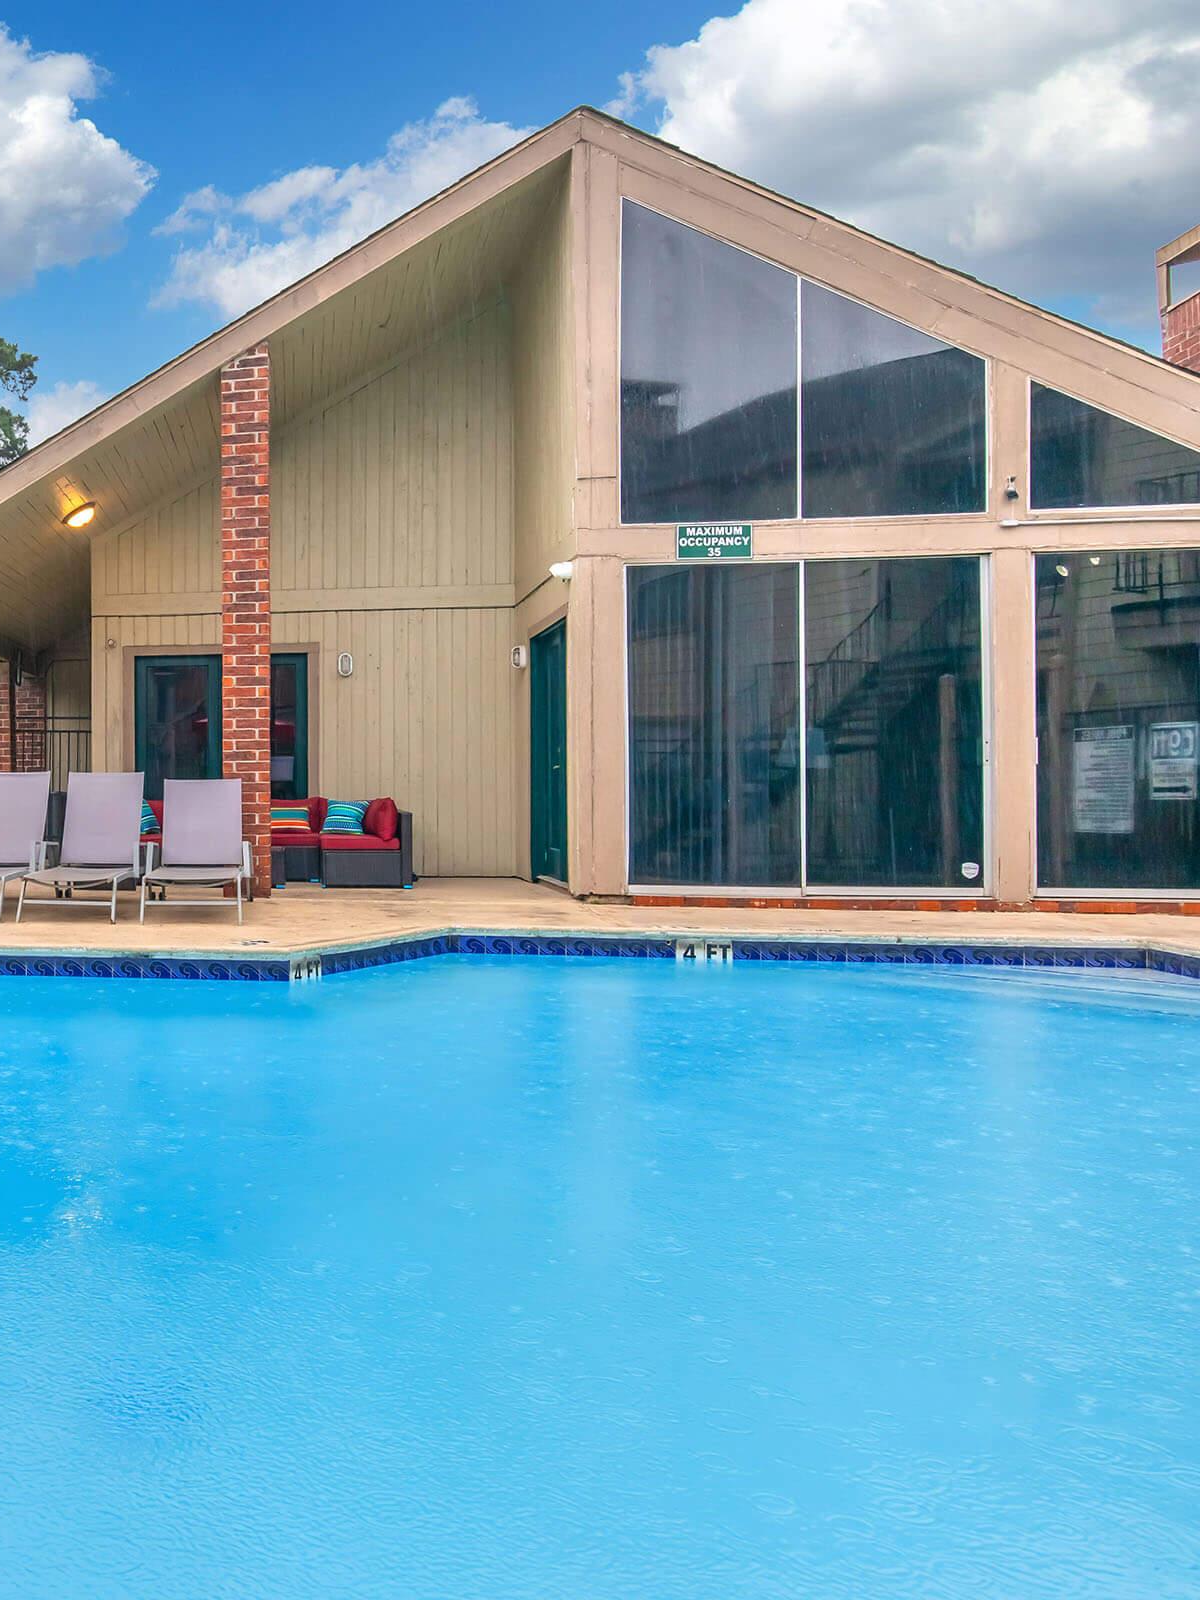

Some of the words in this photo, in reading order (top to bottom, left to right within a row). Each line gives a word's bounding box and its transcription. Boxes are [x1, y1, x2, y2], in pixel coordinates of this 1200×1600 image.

[686, 526, 743, 536] MAXIMUM
[679, 536, 750, 546] OCCUPANCY
[707, 547, 721, 556] 35
[683, 943, 697, 958] 4
[706, 943, 731, 960] FT
[294, 963, 302, 979] 4
[306, 958, 321, 978] FT
